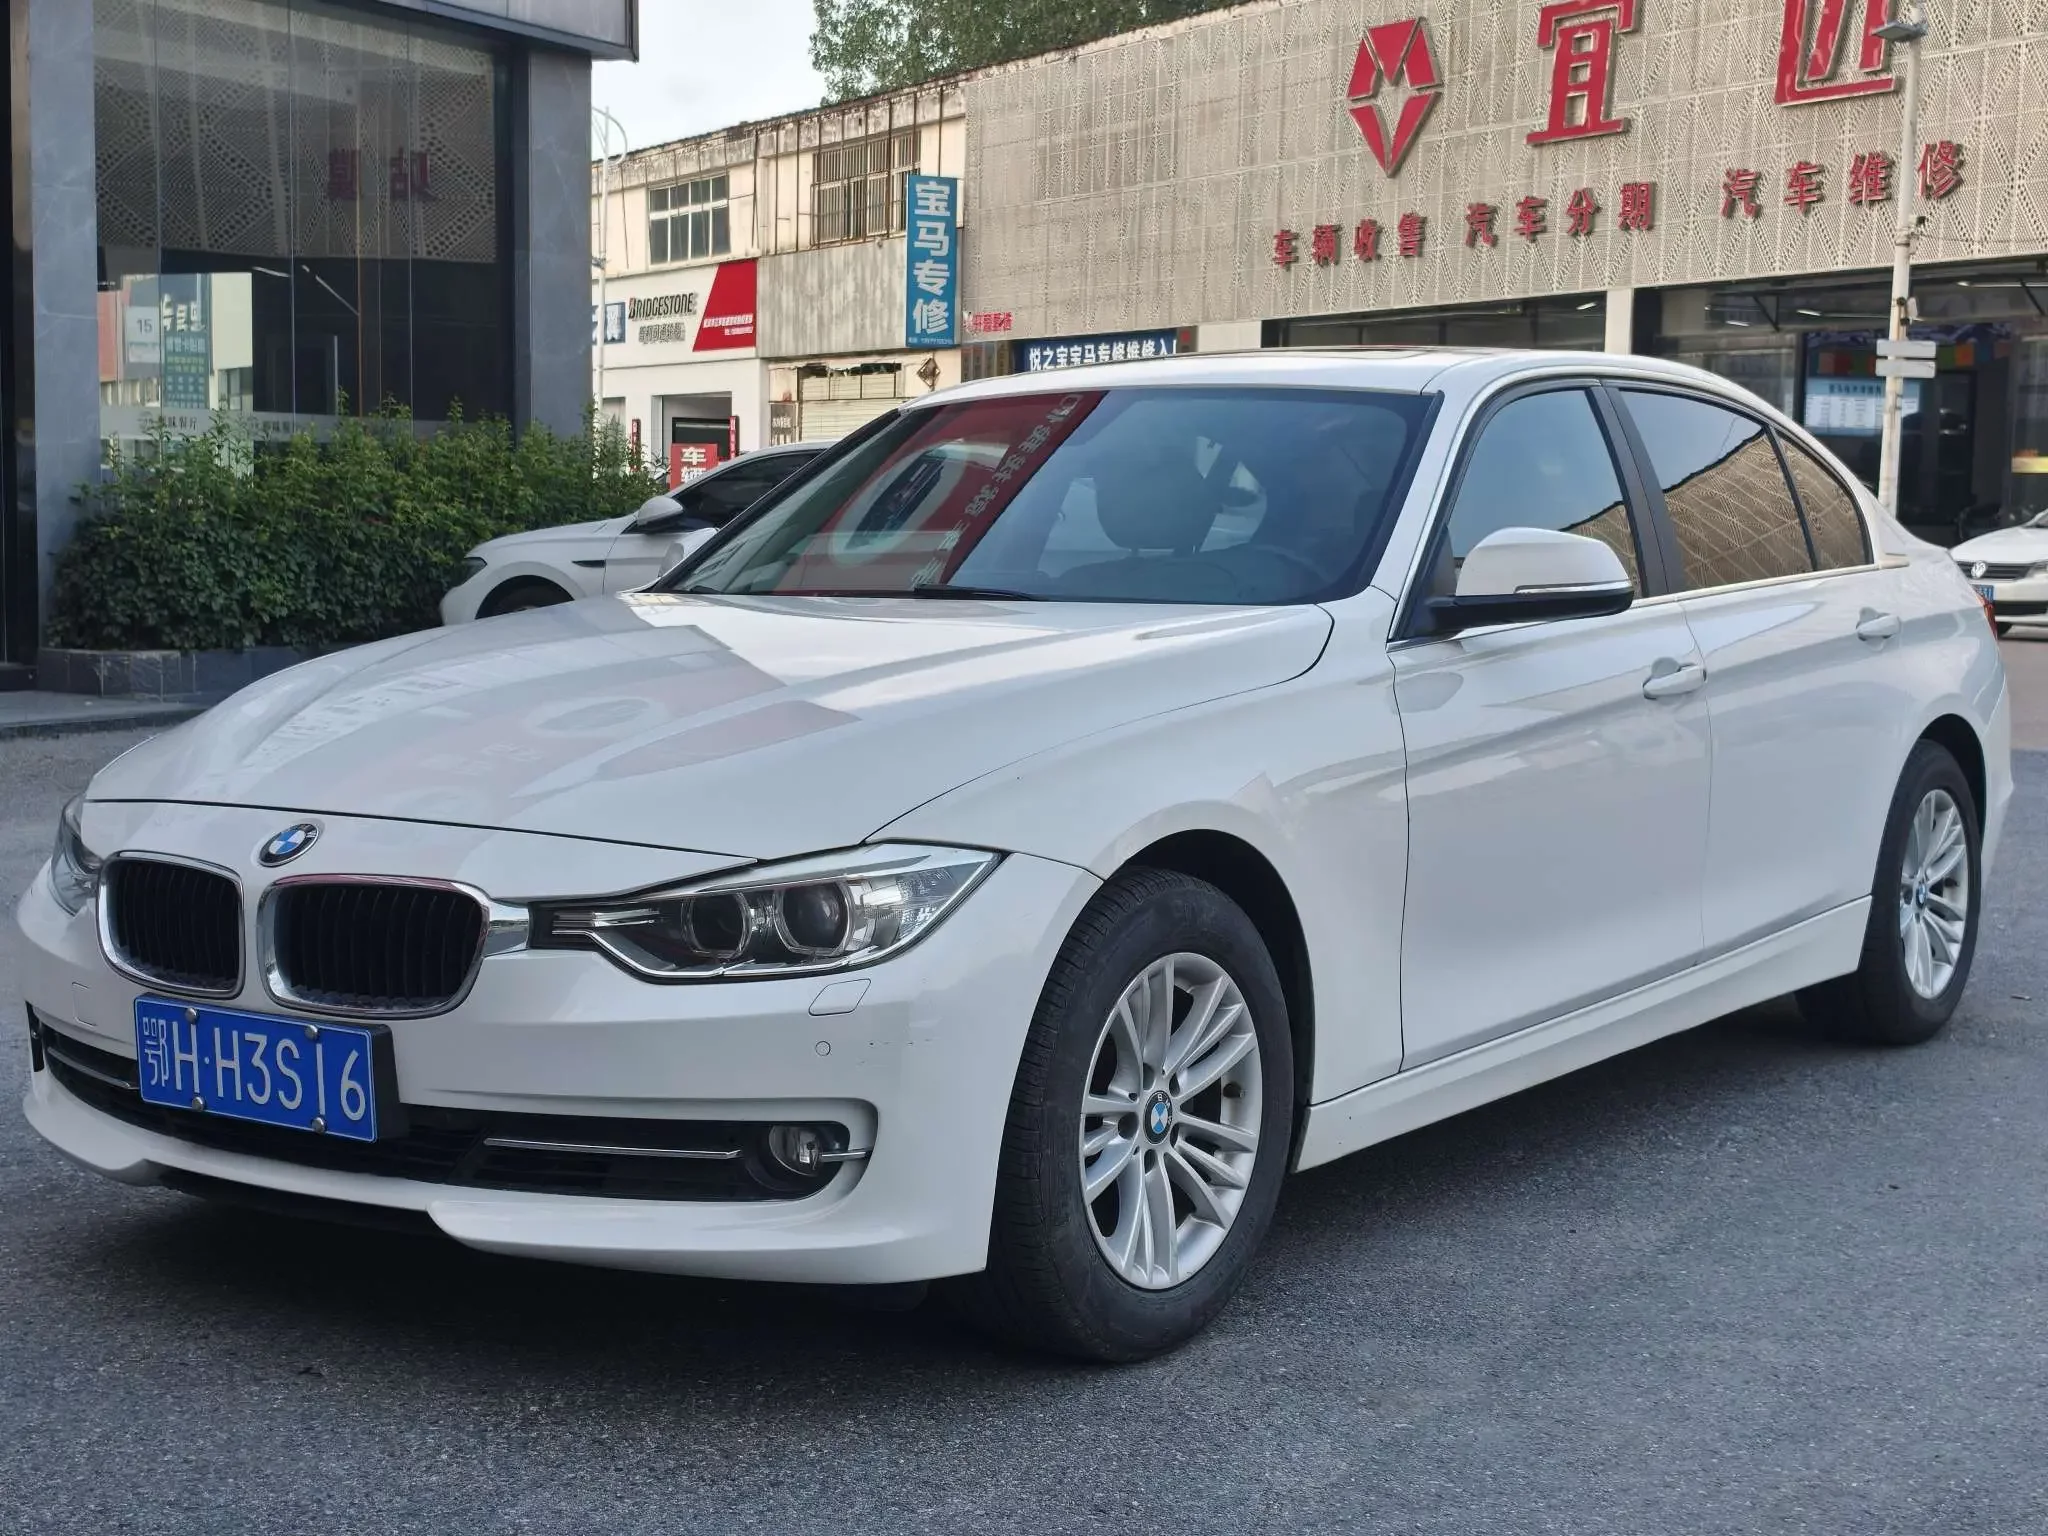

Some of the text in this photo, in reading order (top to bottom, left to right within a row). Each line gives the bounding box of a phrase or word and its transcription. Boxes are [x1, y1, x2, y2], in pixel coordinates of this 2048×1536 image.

[1273, 140, 1963, 270] 车辆收售 汽车分期 汽车维修
[912, 181, 951, 335] 宝马专修
[629, 292, 694, 320] BRIDGESTONE
[137, 318, 153, 334] 15
[1029, 338, 1177, 372] 悦之宝宝马专修维修入
